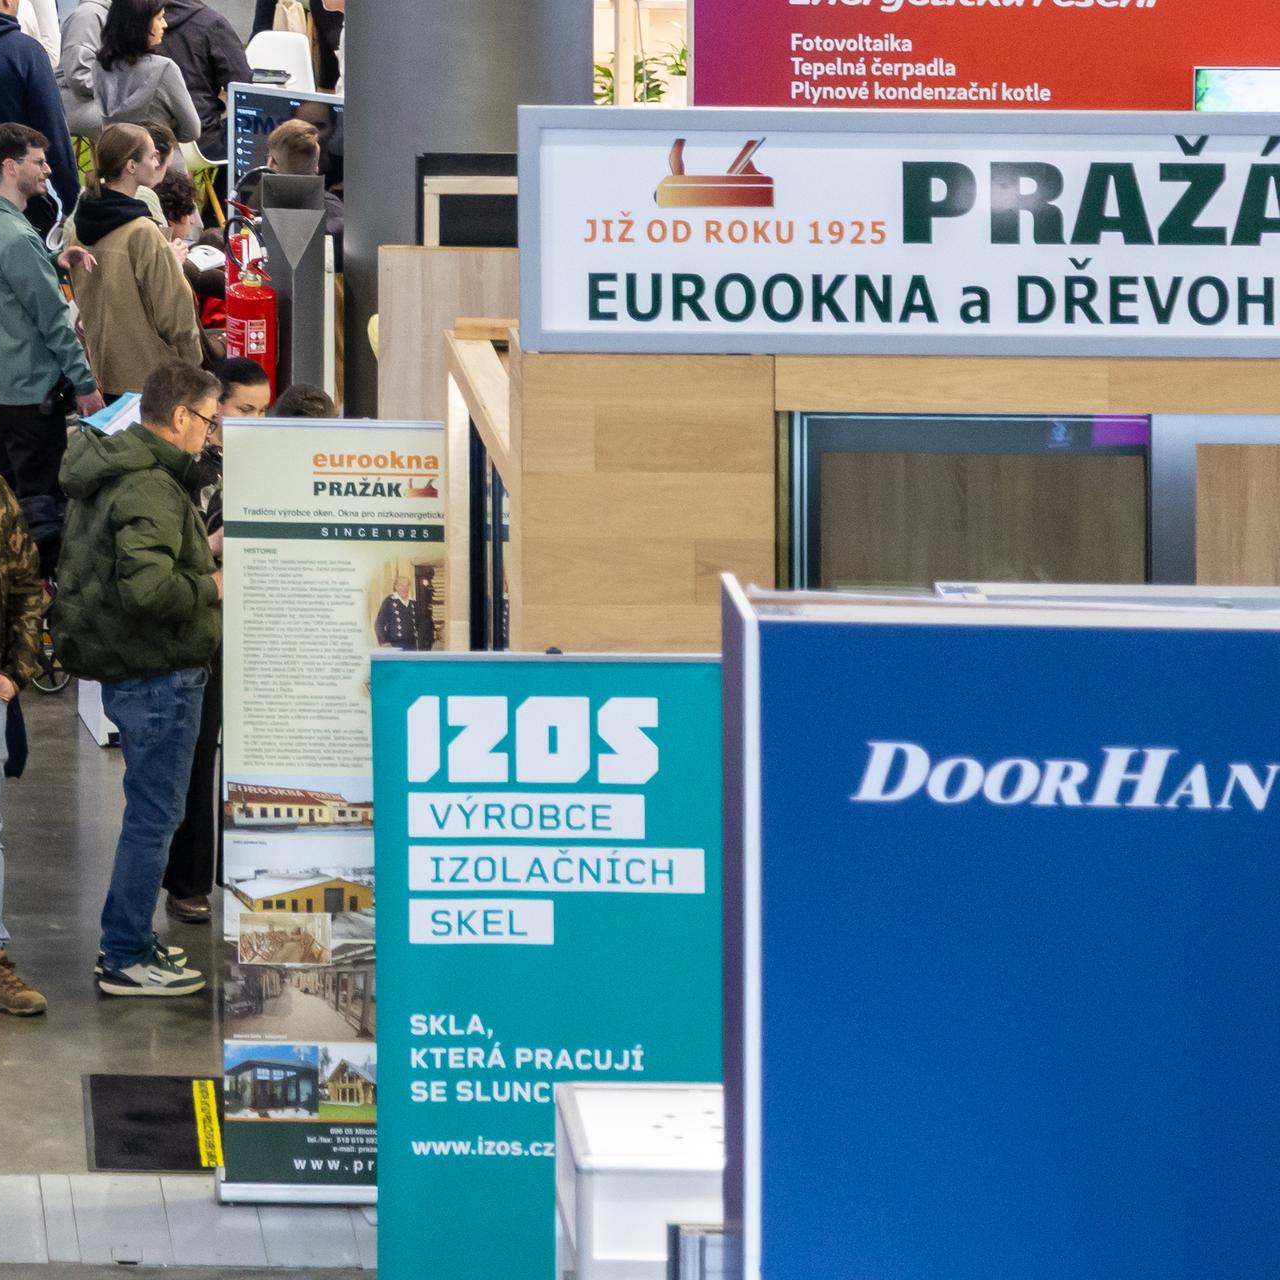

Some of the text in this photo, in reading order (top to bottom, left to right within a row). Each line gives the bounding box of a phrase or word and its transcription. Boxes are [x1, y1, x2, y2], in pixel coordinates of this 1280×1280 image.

[790, 33, 913, 53] Fotovoltaika
[790, 57, 957, 81] Tepelná čerpadla
[790, 81, 1052, 105] Plynové kondenzační kotle
[901, 135, 1280, 247] PRAŽÁ
[583, 210, 887, 245] JIŽ OD ROKU 1925
[586, 257, 1276, 326] EUROOKNA a DŘEVOH
[312, 450, 440, 470] eurookna
[313, 477, 403, 498] PRAŽÁK
[242, 507, 277, 517] Tradiční
[277, 508, 311, 519] výrobce
[312, 508, 335, 519] oken.
[337, 509, 360, 519] Okna
[360, 511, 376, 522] pro
[320, 527, 430, 539] SINCE 1925
[406, 695, 660, 785] IZOS
[429, 795, 613, 832] VÝROBCE
[429, 849, 675, 886] IZOLAČNÍCH
[430, 909, 528, 937] SKEL
[410, 1013, 494, 1040] SKLA,
[410, 1041, 645, 1072] KTERÁ PRACUJÍ
[410, 1080, 555, 1104] SE SLUNC
[411, 1135, 555, 1158] www.izos.cz
